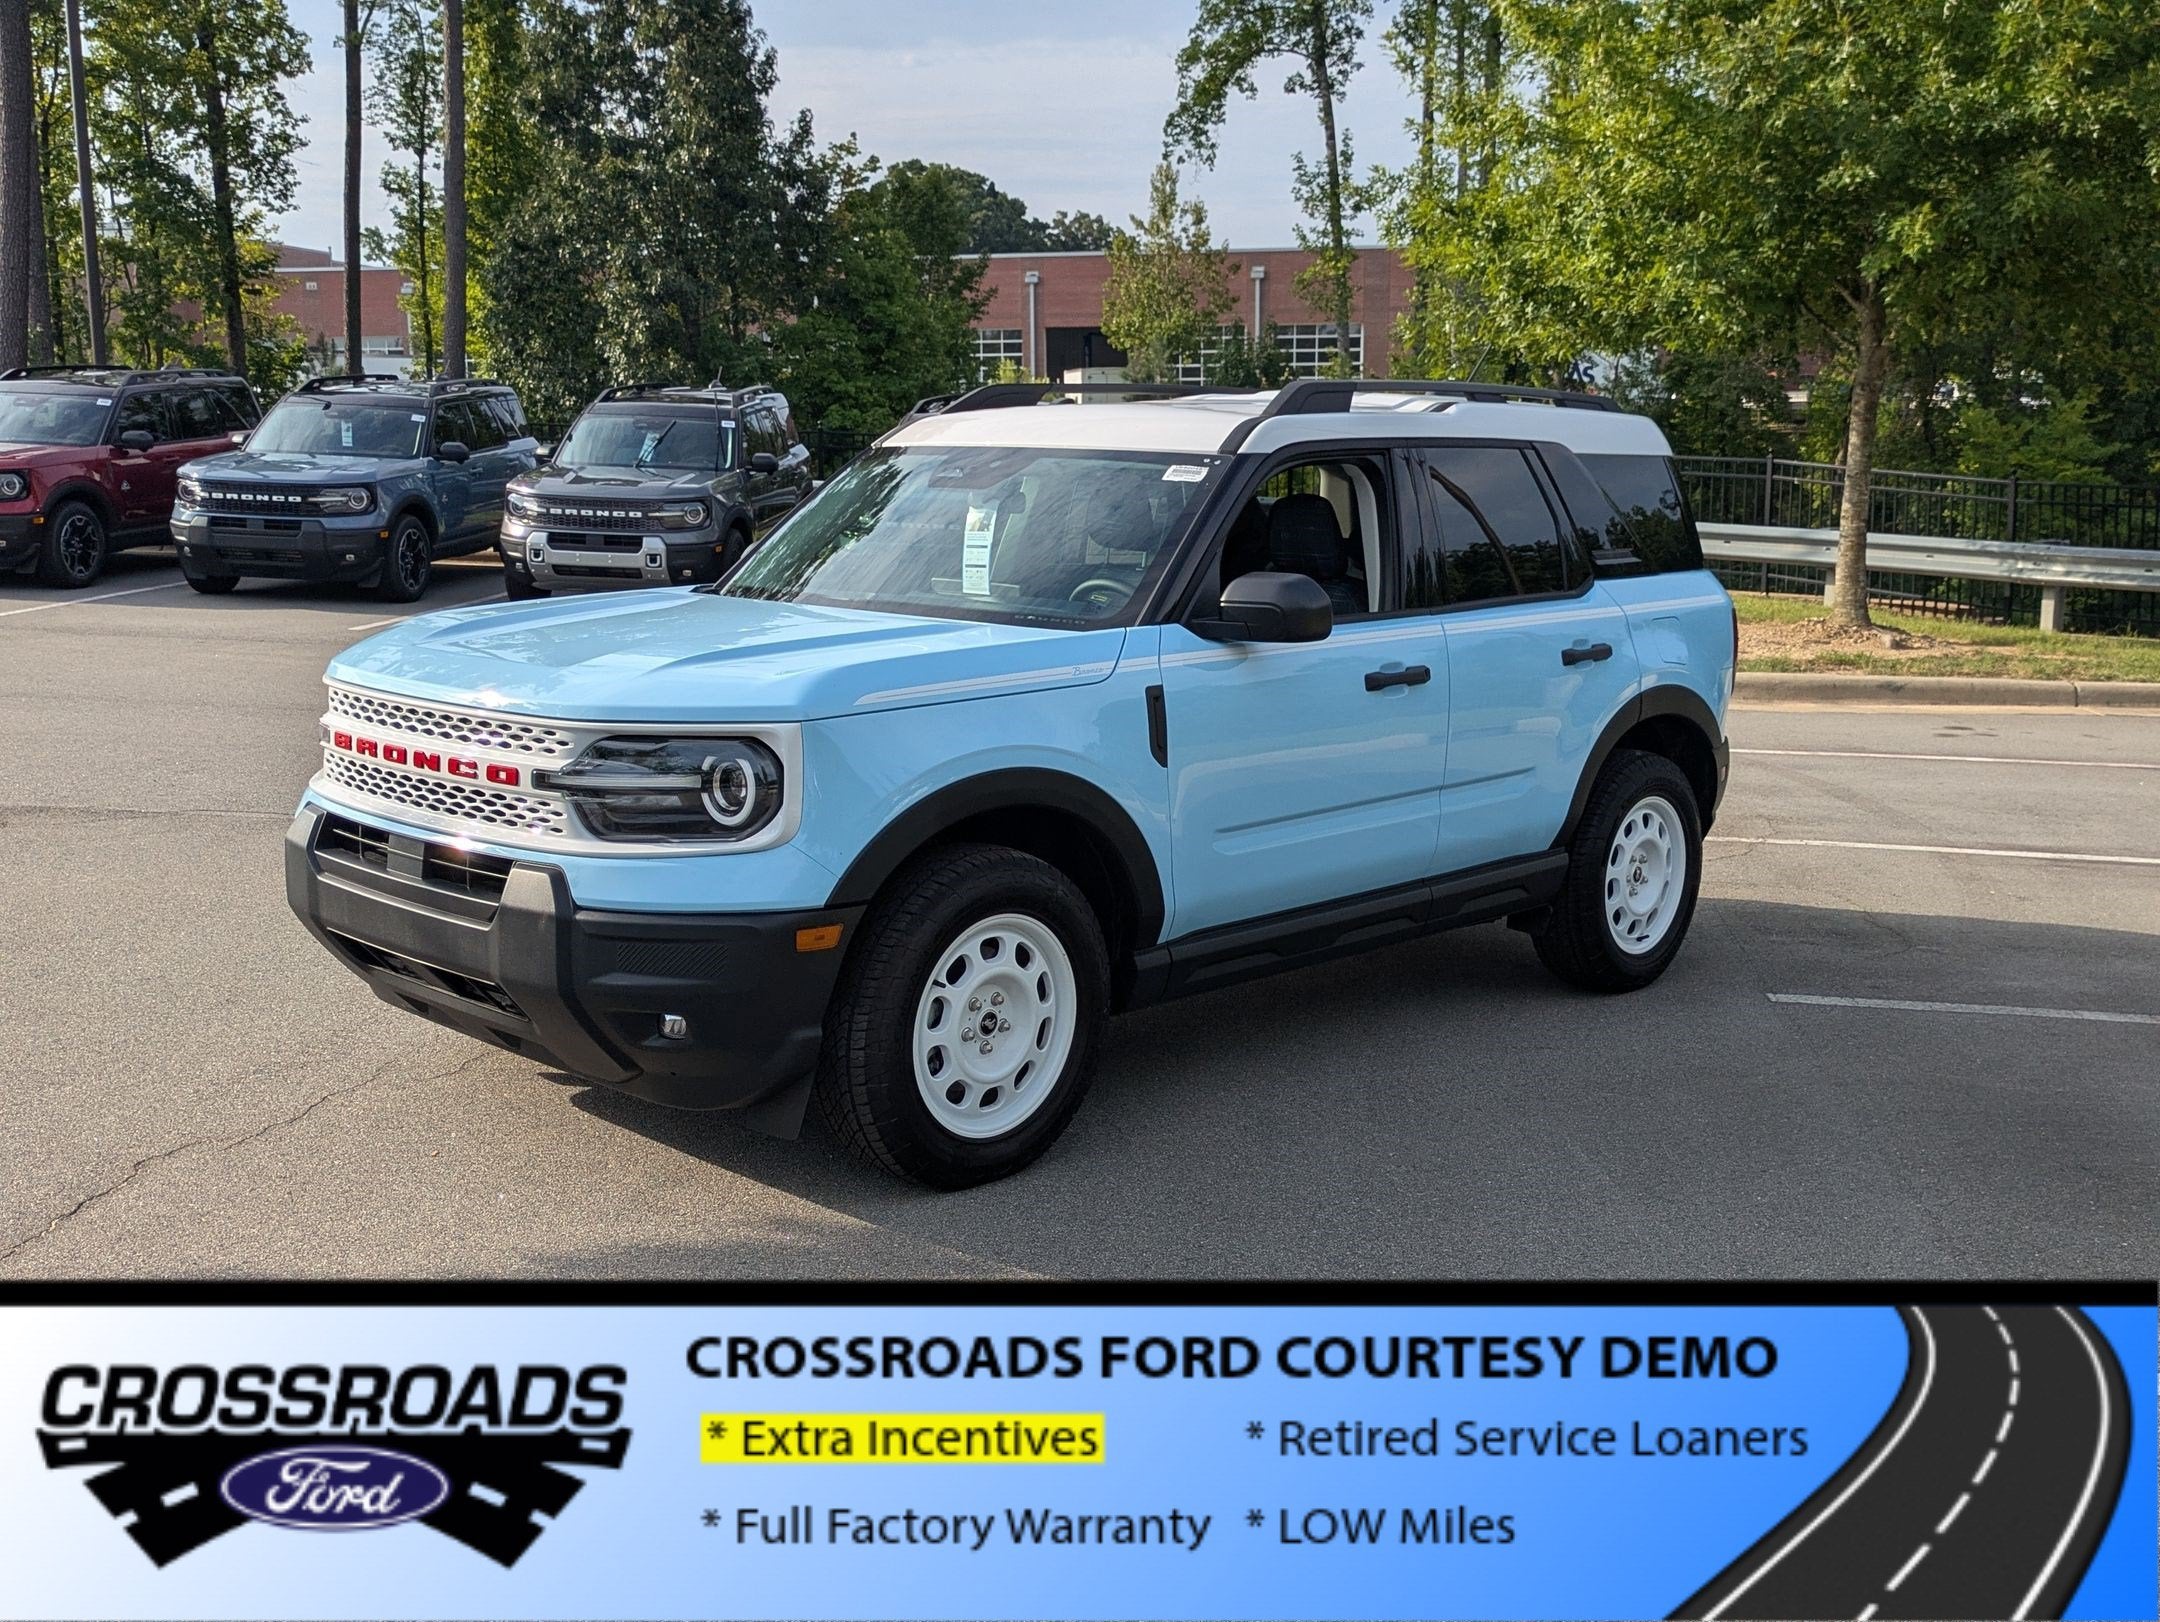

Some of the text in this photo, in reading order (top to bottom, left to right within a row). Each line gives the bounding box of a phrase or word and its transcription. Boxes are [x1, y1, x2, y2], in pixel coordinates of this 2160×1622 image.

[211, 492, 302, 503] BRONCO
[551, 508, 643, 518] BRONCO
[334, 730, 519, 786] BRONCO
